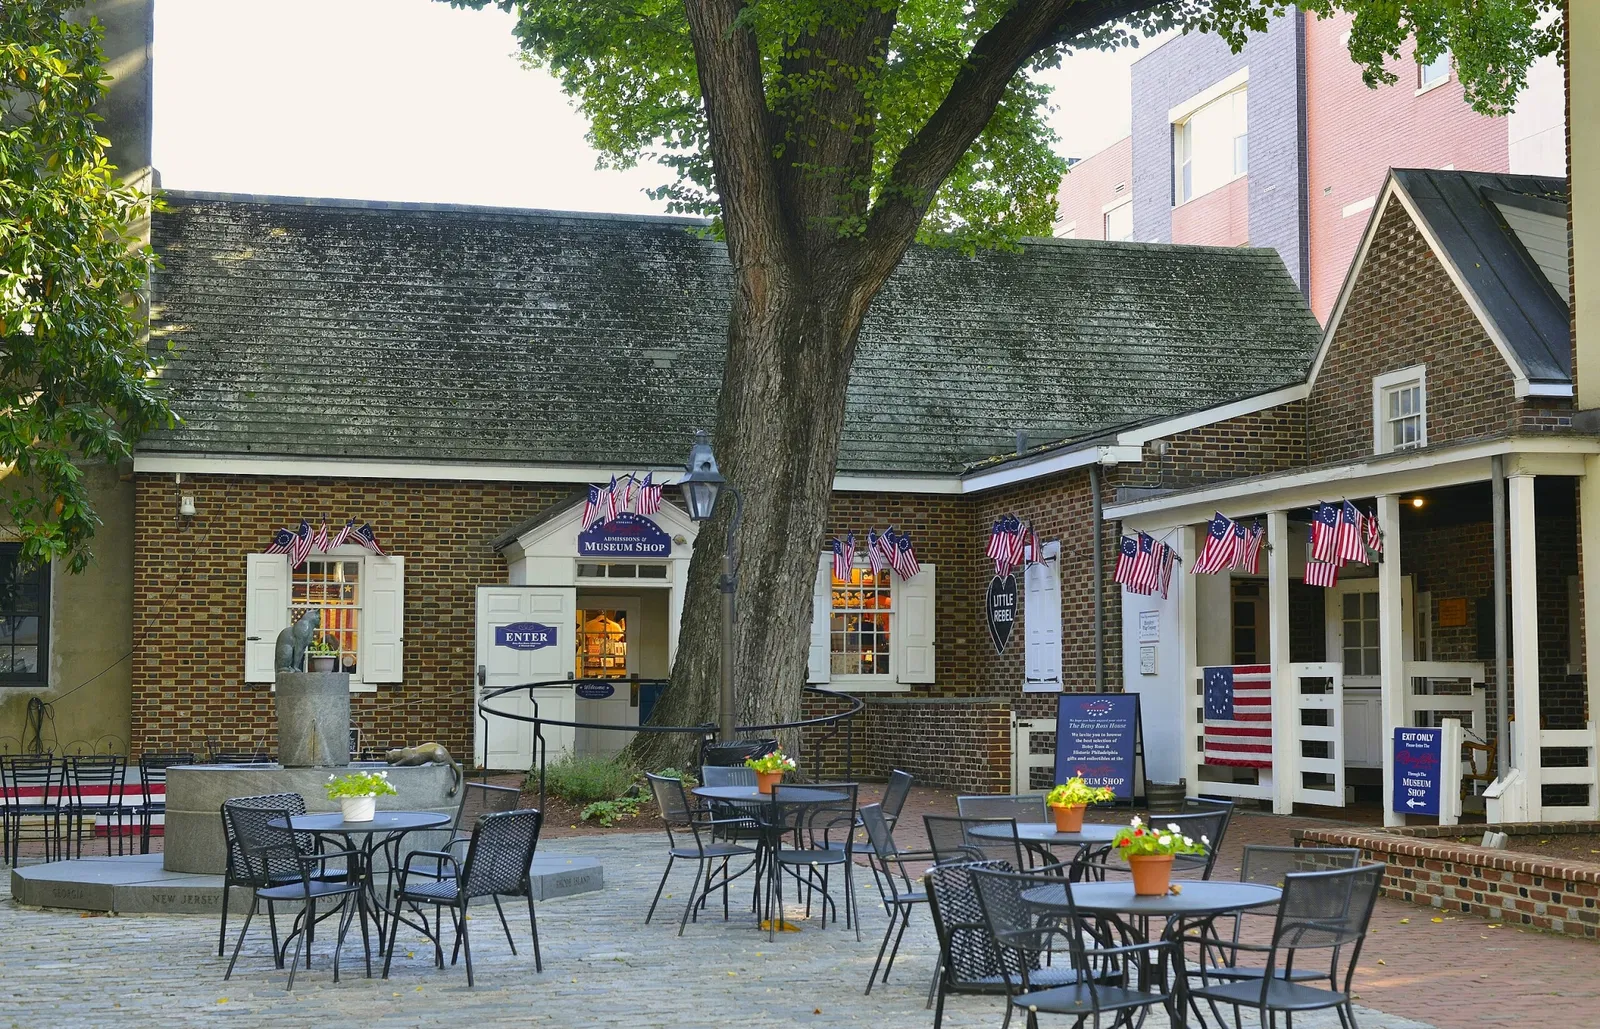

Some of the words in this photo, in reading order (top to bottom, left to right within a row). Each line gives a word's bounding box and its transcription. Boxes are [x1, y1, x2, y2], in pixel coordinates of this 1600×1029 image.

[585, 542, 632, 551] MUSEUM
[636, 542, 665, 552] SHOP
[994, 594, 1013, 606] LITTLE
[994, 609, 1013, 621] REBEL
[506, 632, 548, 641] ENTER
[1403, 778, 1431, 787] MUSEUM
[1408, 788, 1426, 797] SHOP
[53, 888, 83, 899] GEORGIA
[152, 894, 176, 903] NEW
[181, 895, 220, 905] JERSEY
